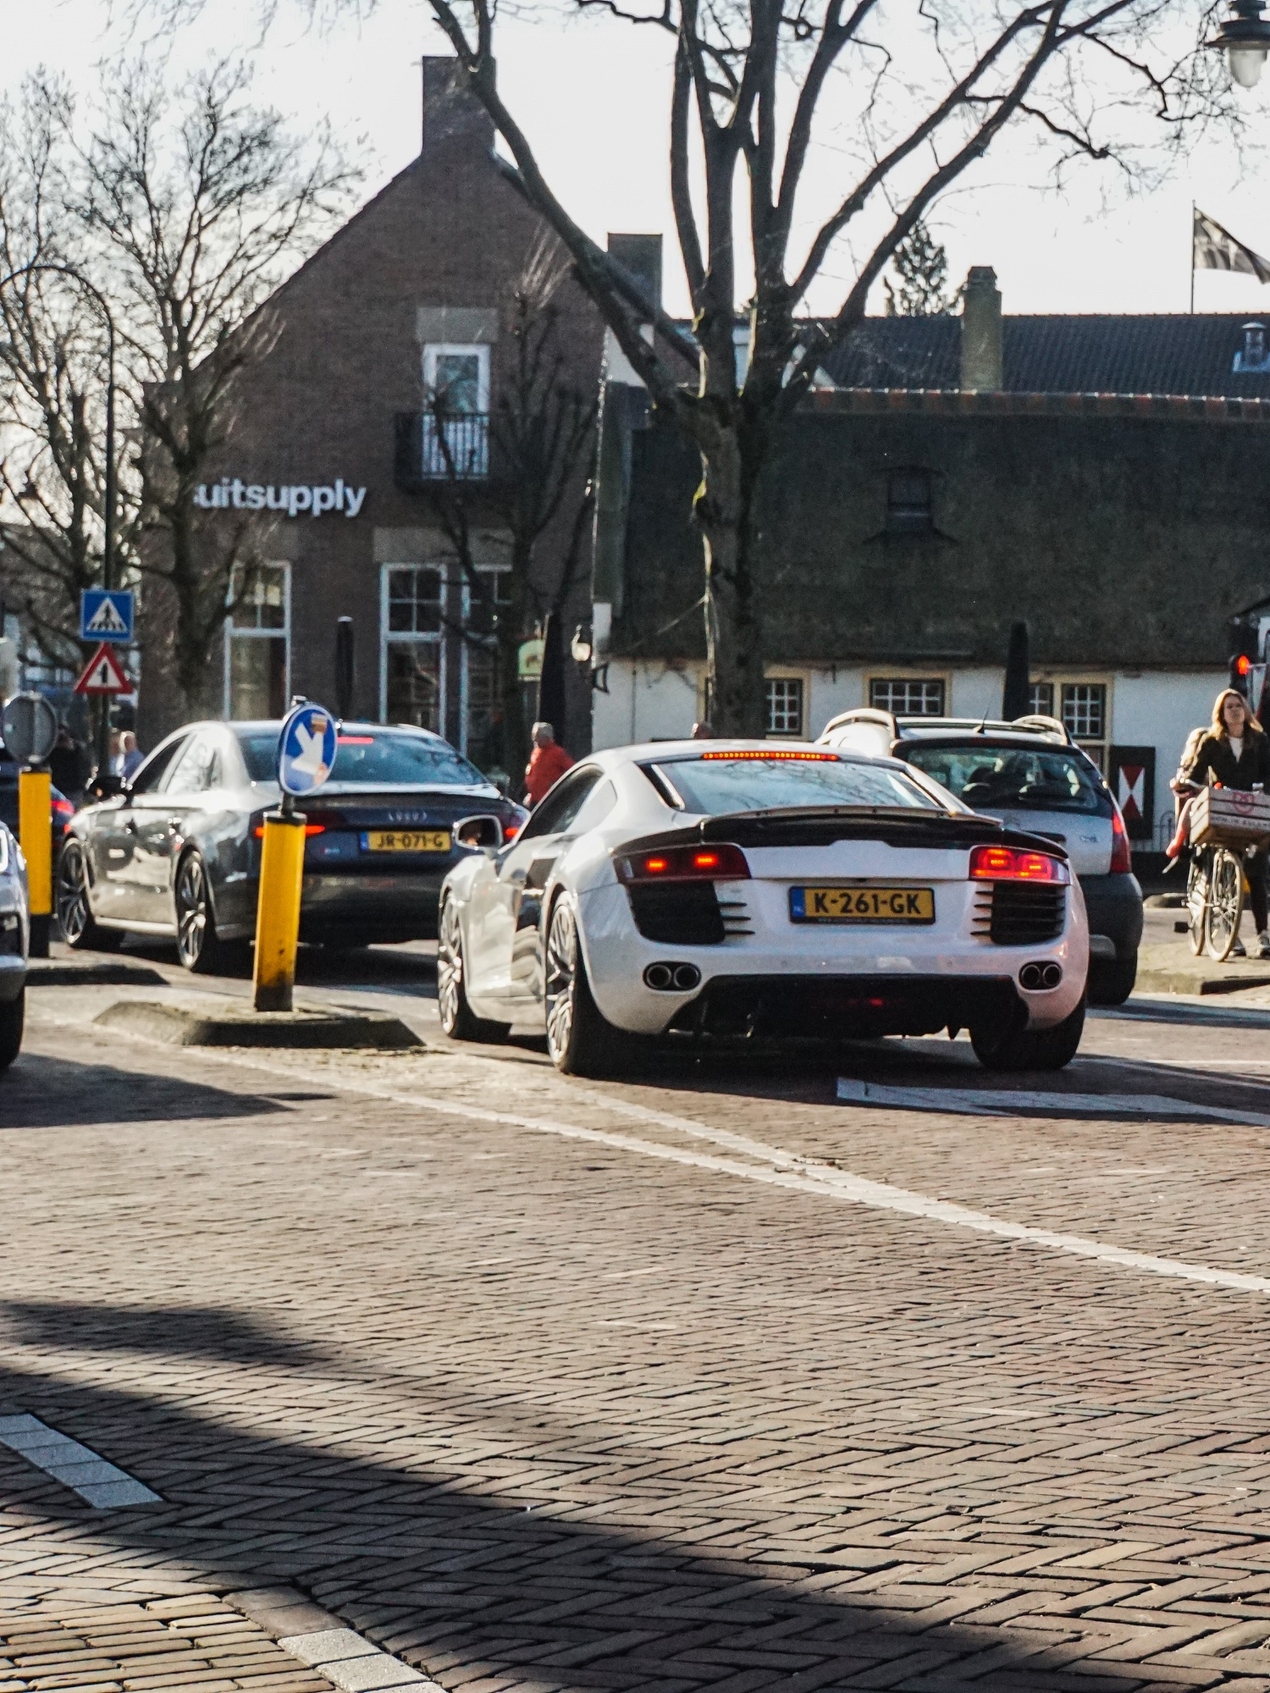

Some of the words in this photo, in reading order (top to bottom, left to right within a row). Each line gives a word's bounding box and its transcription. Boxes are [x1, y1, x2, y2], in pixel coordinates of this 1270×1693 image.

[193, 477, 367, 518] uitsupply
[378, 833, 443, 848] JR-071-G
[813, 892, 921, 914] K-261-GK
